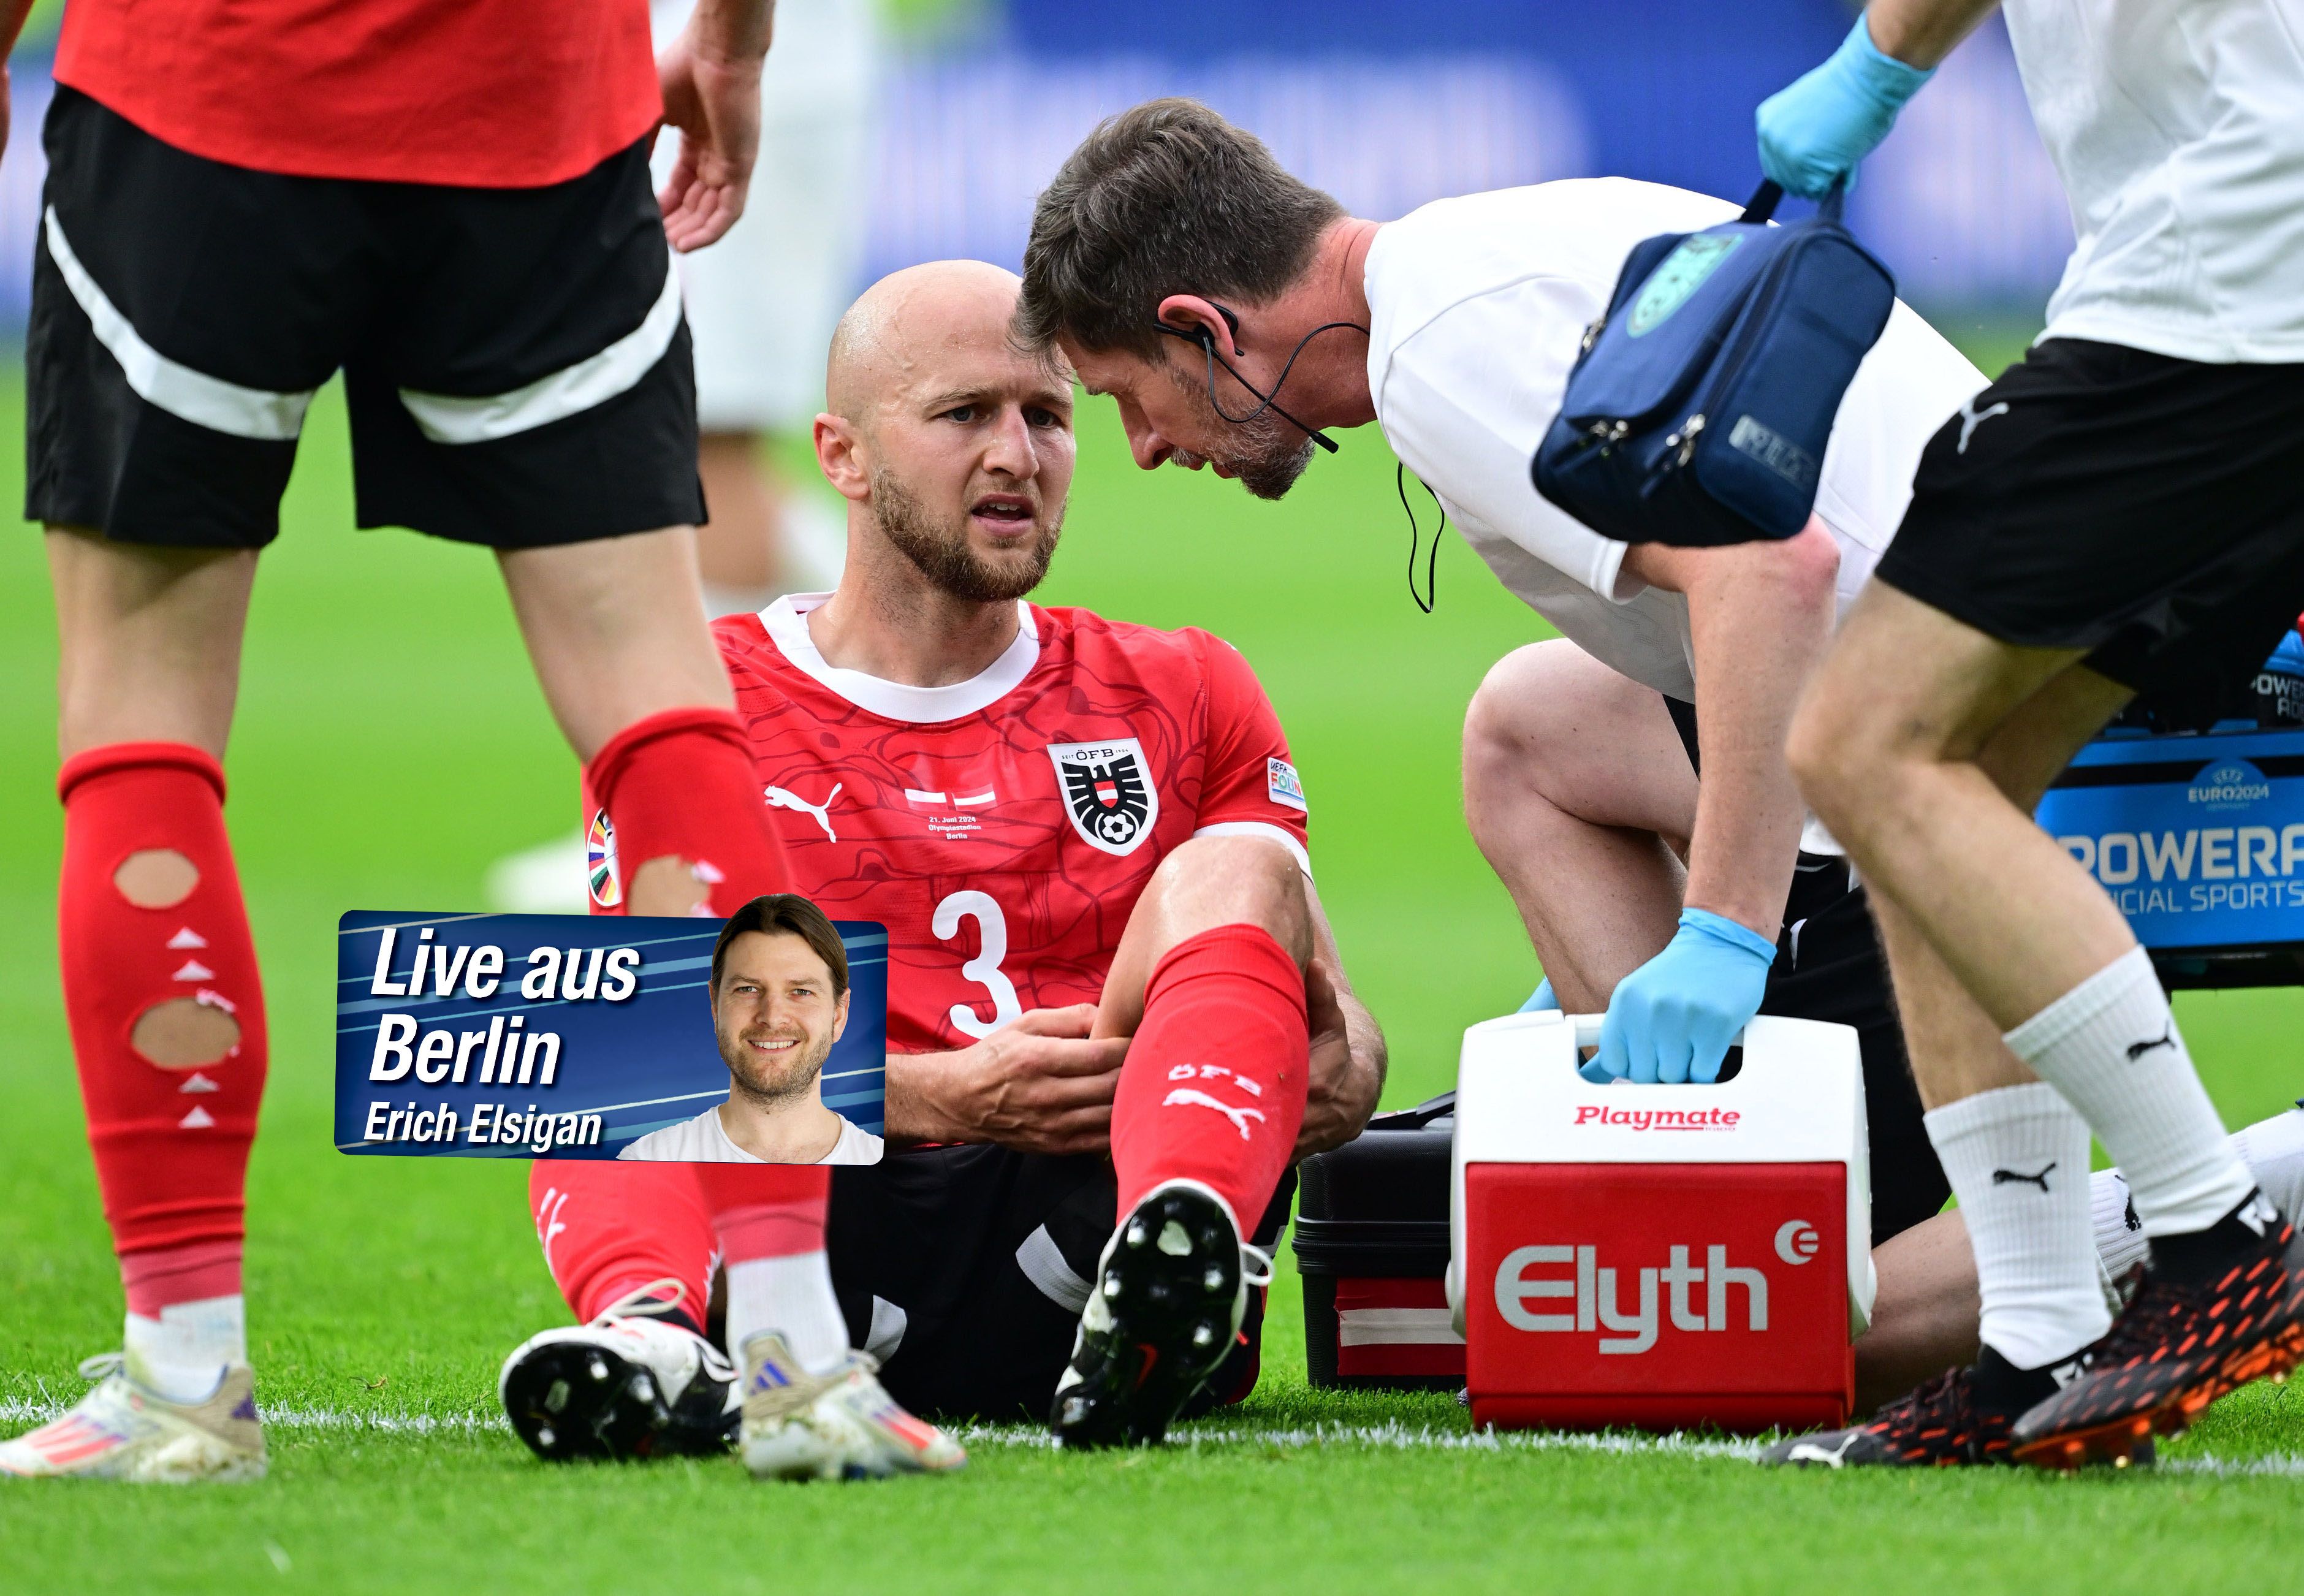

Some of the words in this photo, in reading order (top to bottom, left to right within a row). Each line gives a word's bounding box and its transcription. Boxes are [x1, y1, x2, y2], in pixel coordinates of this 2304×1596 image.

[1076, 748, 1114, 761] ÖFB
[1270, 760, 1288, 773] UEFA
[928, 824, 981, 832] Olympiastadion
[932, 890, 1022, 1039] 3
[1168, 1063, 1262, 1097] ÖFB
[1574, 1106, 1740, 1131] Playmate
[1494, 1245, 1768, 1355] Elyth
